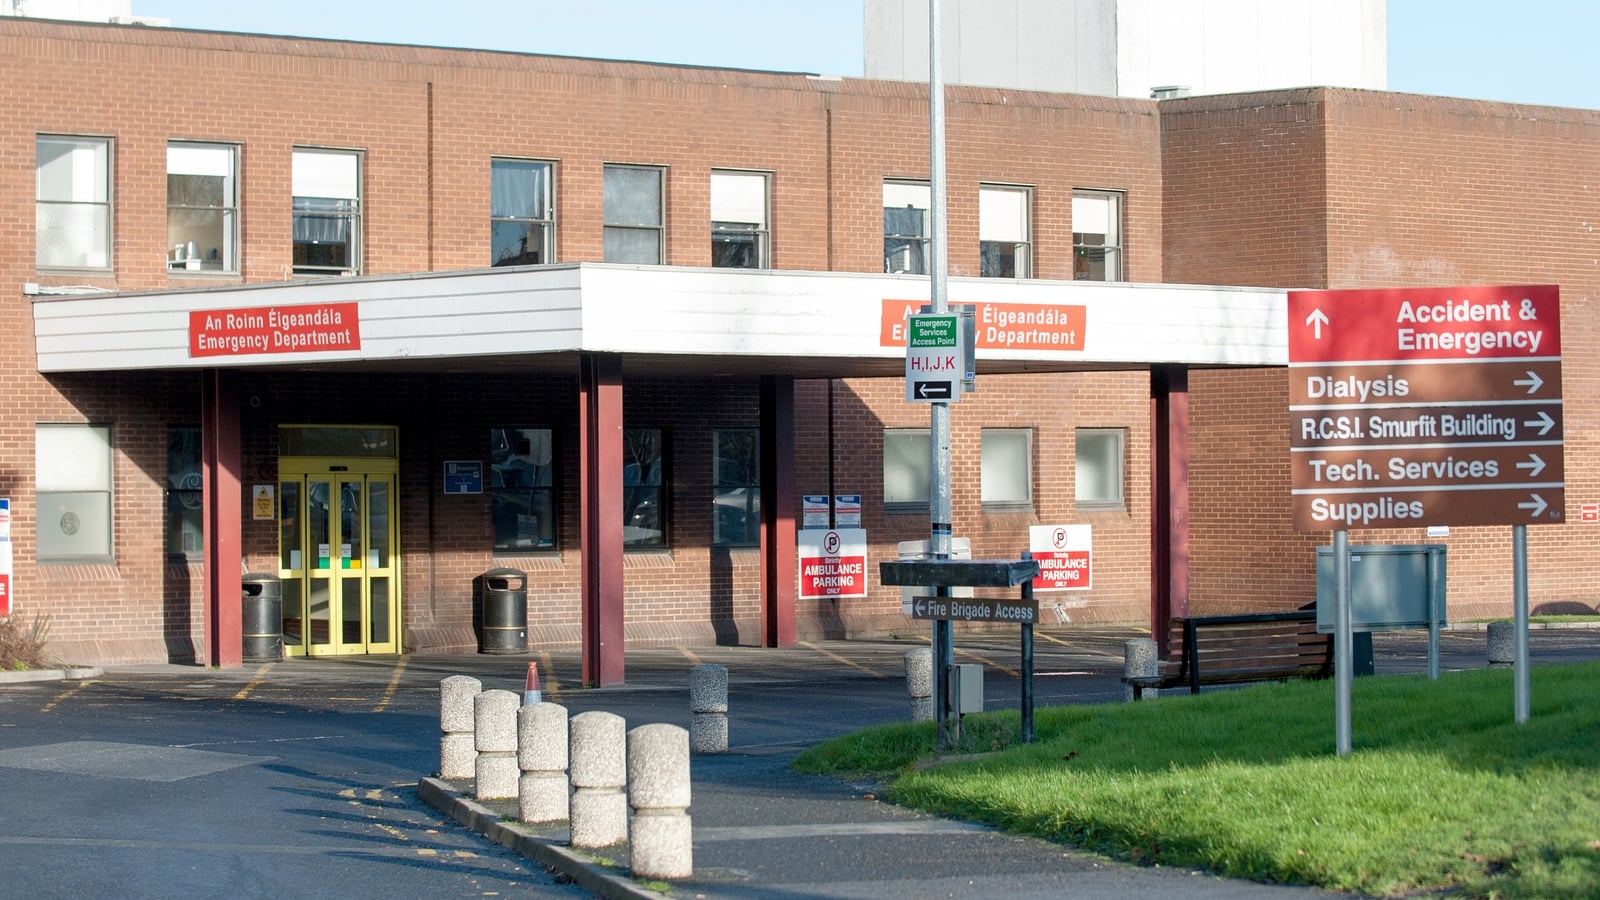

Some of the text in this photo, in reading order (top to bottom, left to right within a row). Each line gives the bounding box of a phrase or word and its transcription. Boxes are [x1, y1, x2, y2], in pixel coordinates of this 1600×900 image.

[205, 308, 341, 331] An Roinn Éigeandála
[903, 304, 1068, 327] A Éigeandála
[1396, 299, 1537, 323] Accident &
[915, 320, 952, 328] Emergency
[919, 328, 947, 336] Services
[198, 328, 351, 352] Emergency Department
[912, 337, 955, 346] Access Point
[986, 327, 1076, 345] Department
[1398, 328, 1543, 354] Emergency
[911, 356, 955, 372] H,I,J,K
[1307, 375, 1409, 402] Dialysis
[1302, 414, 1515, 440] R.C.S.I. Smurfit Building
[1309, 457, 1499, 481] Tech. Services
[1311, 497, 1424, 525] Supplies
[805, 564, 862, 576] AMBULANCE
[1043, 570, 1079, 580] PARKING
[813, 576, 854, 587] PARKING
[928, 601, 1033, 620] Fire Brigade Access
